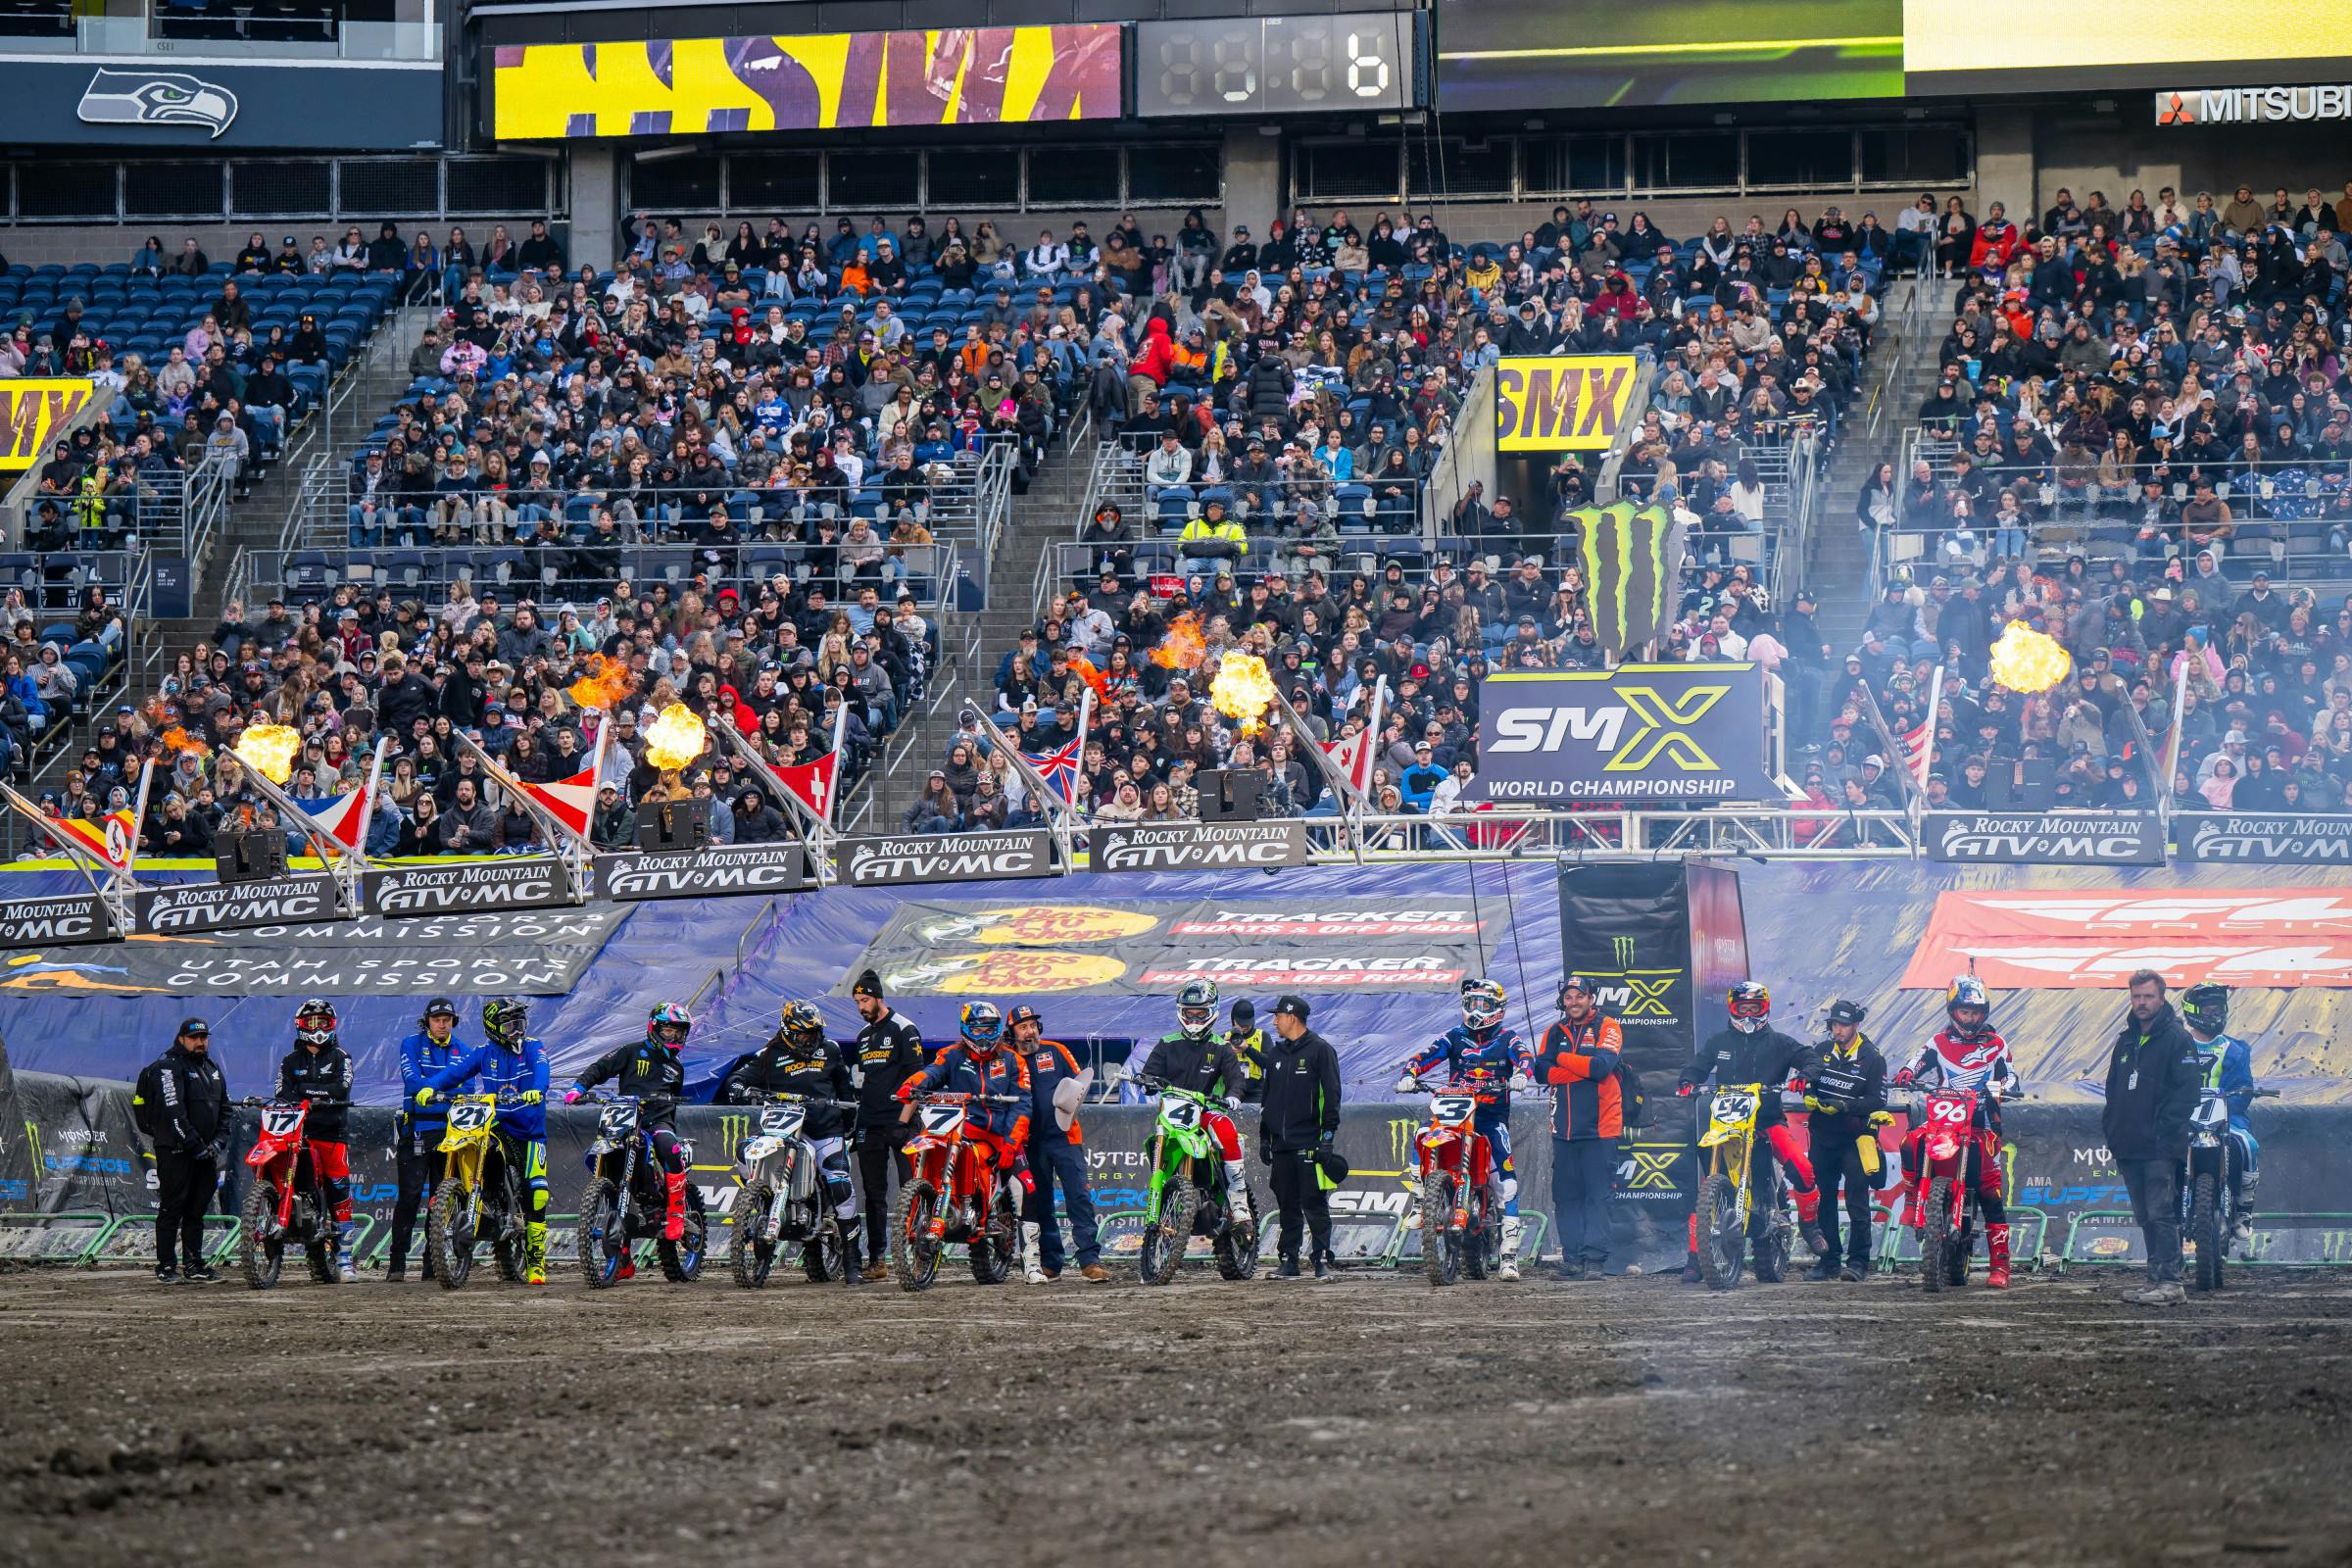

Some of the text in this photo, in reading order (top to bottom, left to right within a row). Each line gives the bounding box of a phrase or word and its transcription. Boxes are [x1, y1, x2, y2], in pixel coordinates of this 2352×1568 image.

[2200, 85, 2352, 122] MITSUBI
[1498, 368, 1628, 439] SMX
[1699, 596, 1714, 615] 2
[1487, 685, 1733, 771] SMX
[1489, 779, 1735, 796] WORLD CHAMPIONSHIP
[1973, 816, 2142, 835] ROCKY MOUNTAIN
[2225, 818, 2289, 835] ROCKY
[1131, 826, 1290, 845] ROCKY MOUNTAIN
[879, 836, 1034, 858] ROCKY MOUNTAIN
[636, 851, 788, 872] ROCKY MOUNTAIN
[403, 865, 552, 888] ROCKY MOUNTAIN
[175, 880, 321, 906] ROCKY MOUNTAIN
[5, 901, 93, 918] MOUNTAIN
[1020, 906, 1114, 919] Bass
[1215, 910, 1469, 923] TRACKER
[214, 925, 592, 938] COMMISSION
[1009, 928, 1125, 941] Shops
[1181, 924, 1284, 934] BOATS
[1317, 924, 1379, 934] OFF
[1385, 923, 1475, 934] ROAD
[180, 958, 569, 970] UTAH SPORTS
[985, 952, 1081, 965] Bass
[1185, 956, 1447, 971] TRACKER
[167, 971, 557, 986] COMMISSION
[969, 976, 1093, 989] Shops
[1151, 972, 1256, 983] BOATS
[1291, 974, 1357, 984] OFF
[1359, 971, 1453, 983] ROAD
[1594, 978, 1676, 1015] MX
[785, 1060, 825, 1074] ROCKTAR
[453, 1106, 486, 1126] 21
[604, 1105, 636, 1127] 32
[764, 1110, 804, 1129] 27
[929, 1106, 963, 1131] 7
[1168, 1102, 1196, 1126] 4
[1436, 1100, 1471, 1121] 3
[1934, 1102, 1967, 1122] 96
[268, 1113, 300, 1132] 17
[1087, 1172, 1137, 1181] ERGY
[1616, 1152, 1682, 1189] MX
[2026, 1176, 2052, 1187] AMA
